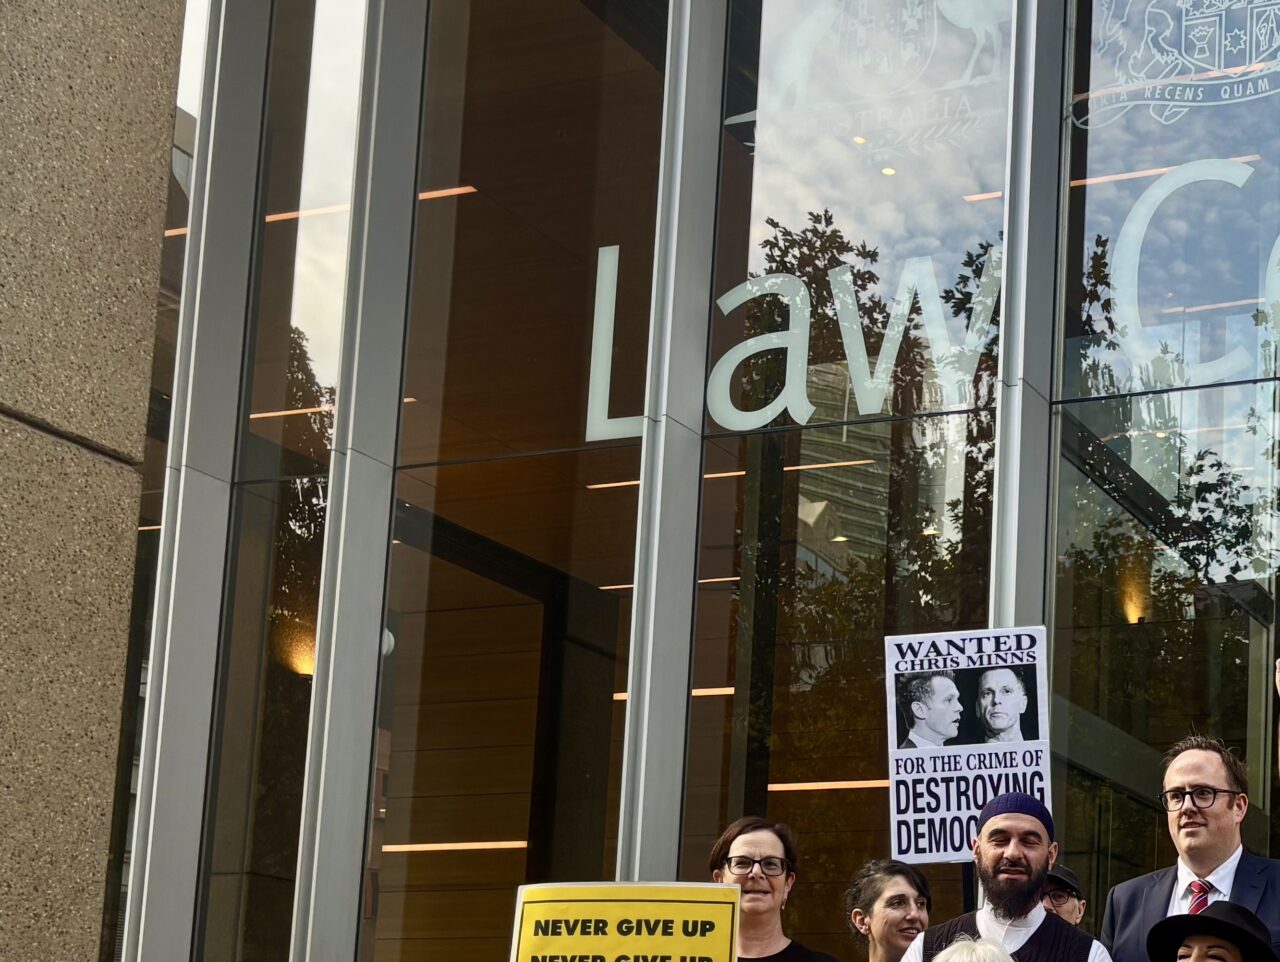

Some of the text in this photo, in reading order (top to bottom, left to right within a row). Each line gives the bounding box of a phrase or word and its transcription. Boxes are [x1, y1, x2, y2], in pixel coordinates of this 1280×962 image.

[1144, 85, 1205, 101] RECENS
[1220, 79, 1270, 100] QUAM
[585, 244, 1004, 433] Law
[894, 633, 1037, 660] WANTED
[894, 651, 1037, 673] CHRIS MINNS
[895, 750, 1044, 775] FOR THE CRIME OF
[896, 814, 979, 856] DEMOC
[533, 918, 716, 937] NEVER GIVE UP
